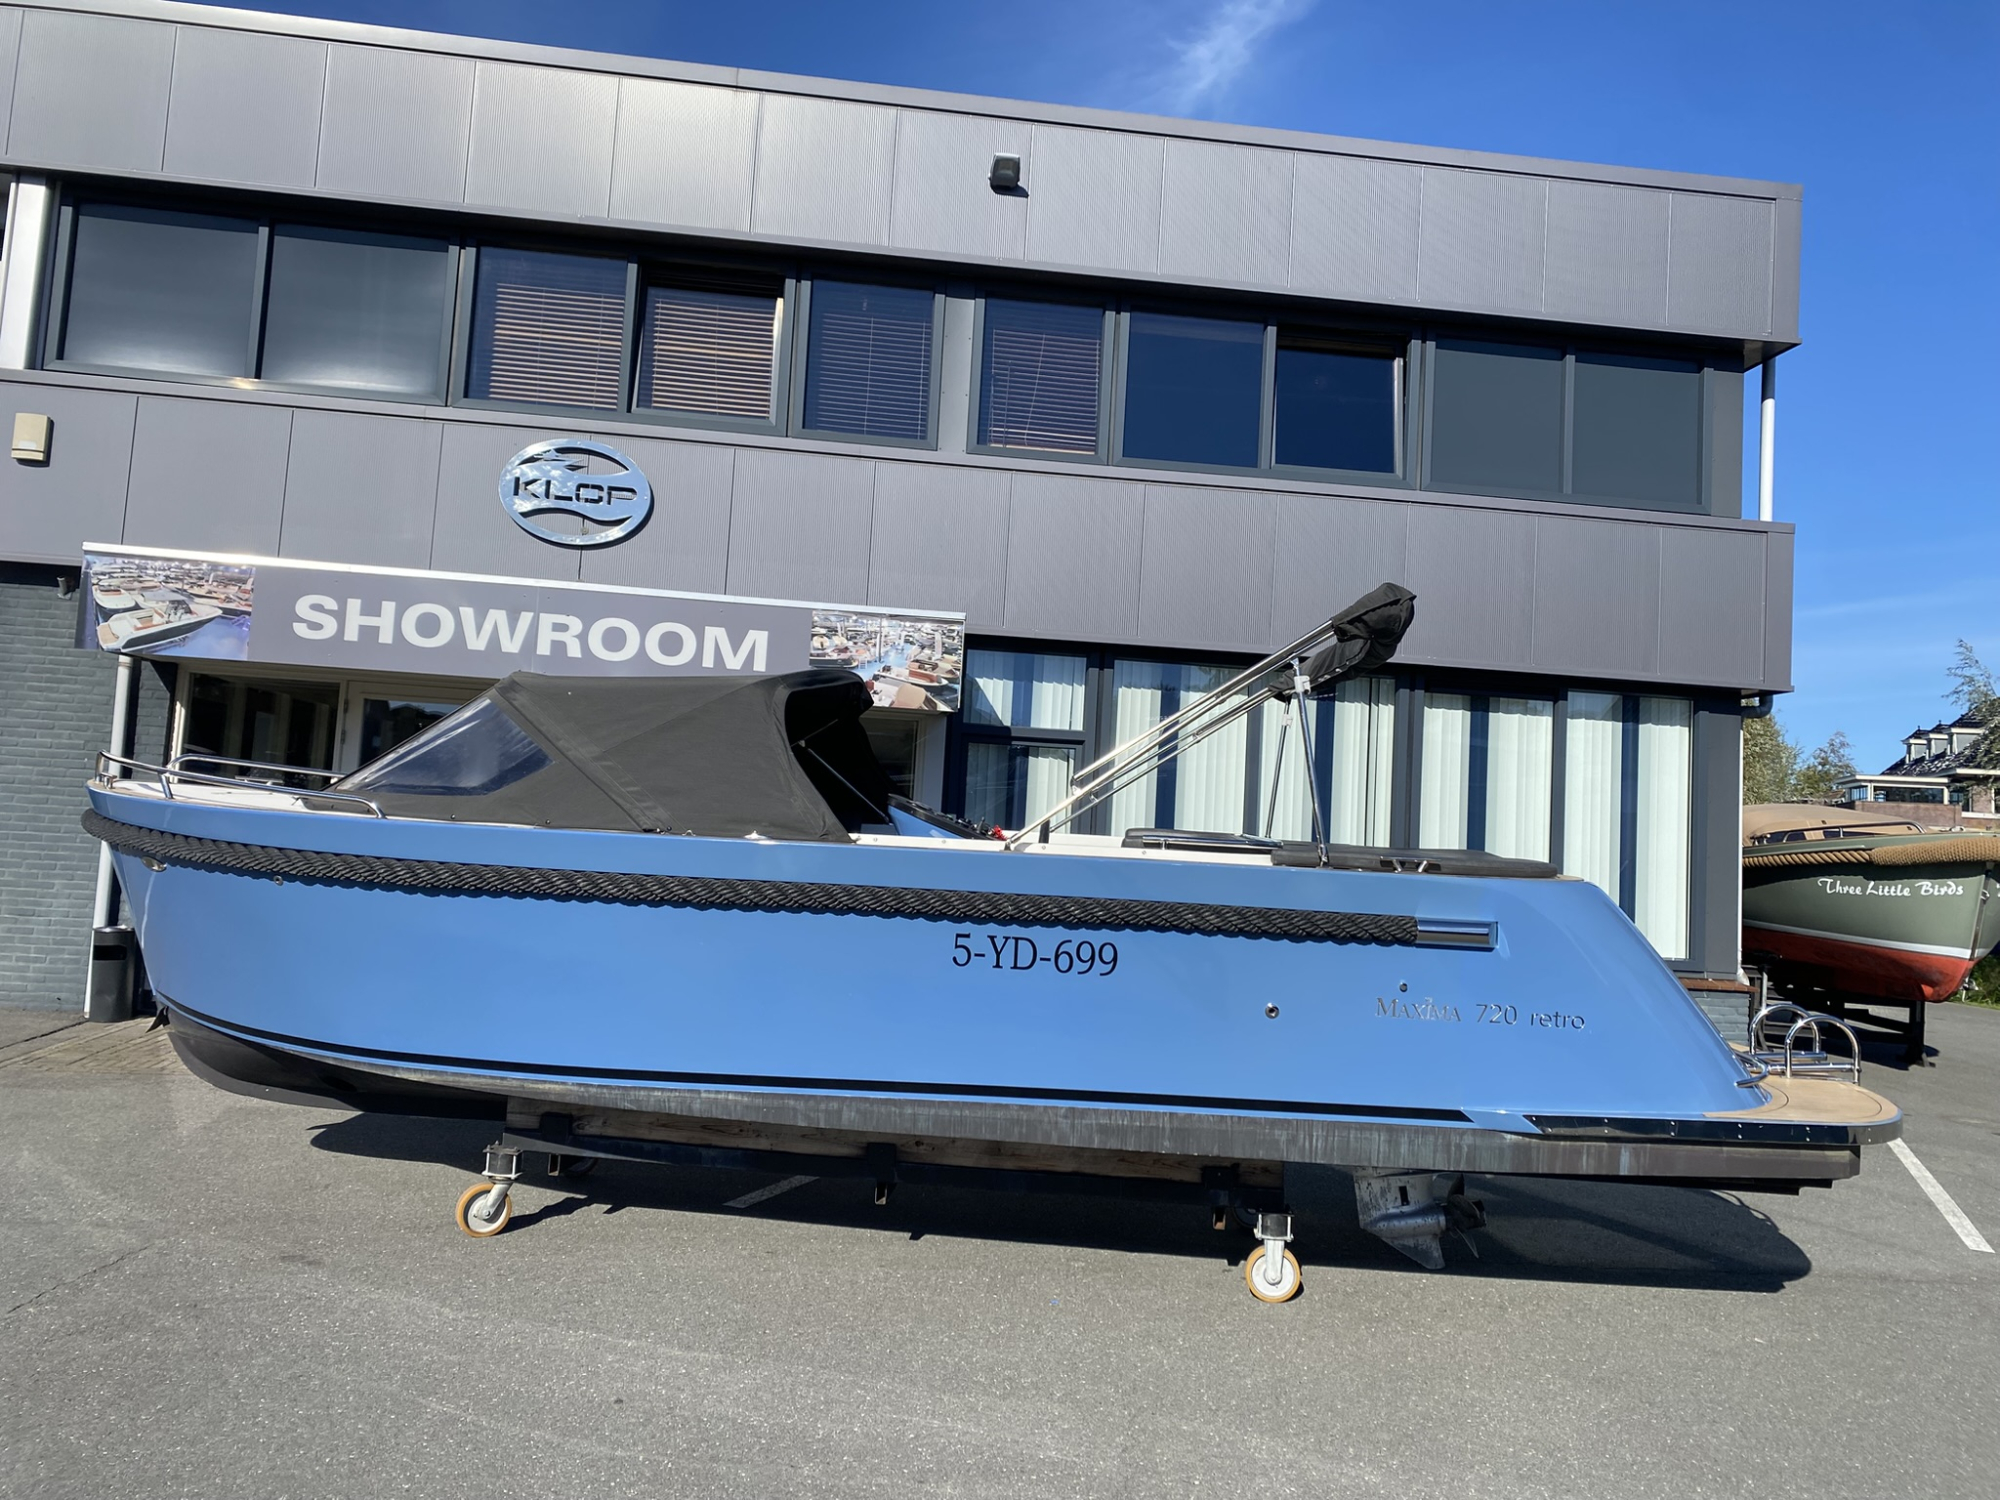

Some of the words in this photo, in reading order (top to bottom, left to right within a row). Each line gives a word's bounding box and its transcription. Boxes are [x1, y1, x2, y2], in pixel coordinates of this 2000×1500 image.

[513, 476, 638, 505] KLOP
[292, 594, 769, 672] SHOWROOM
[1817, 878, 1862, 895] Three
[1866, 880, 1911, 896] Little
[1915, 881, 1964, 896] Birds
[952, 932, 1118, 977] 5-YD-699
[1476, 1003, 1517, 1025] 720
[1530, 1011, 1585, 1030] retro
